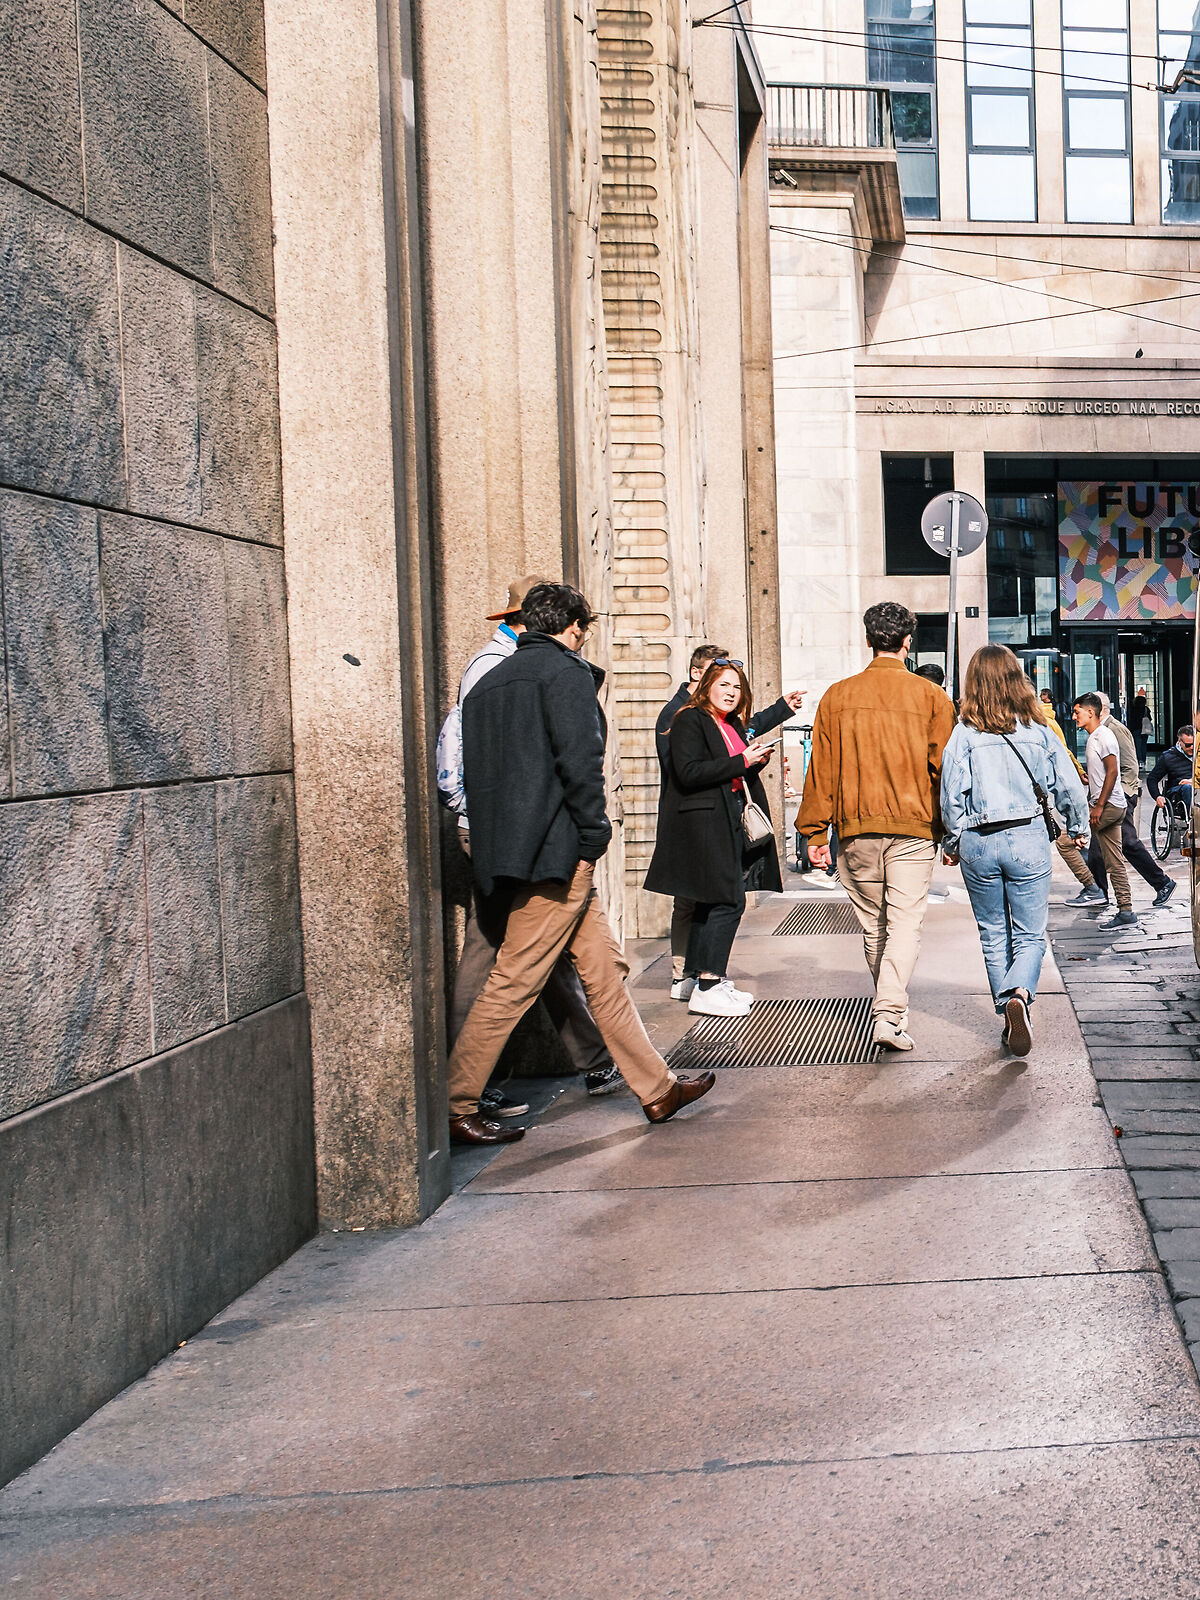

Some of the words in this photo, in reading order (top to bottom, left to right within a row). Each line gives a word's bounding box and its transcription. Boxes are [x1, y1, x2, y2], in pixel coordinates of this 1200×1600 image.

[1075, 402, 1120, 414] URGEO
[1130, 402, 1158, 414] NAM
[1118, 527, 1200, 559] LIB
